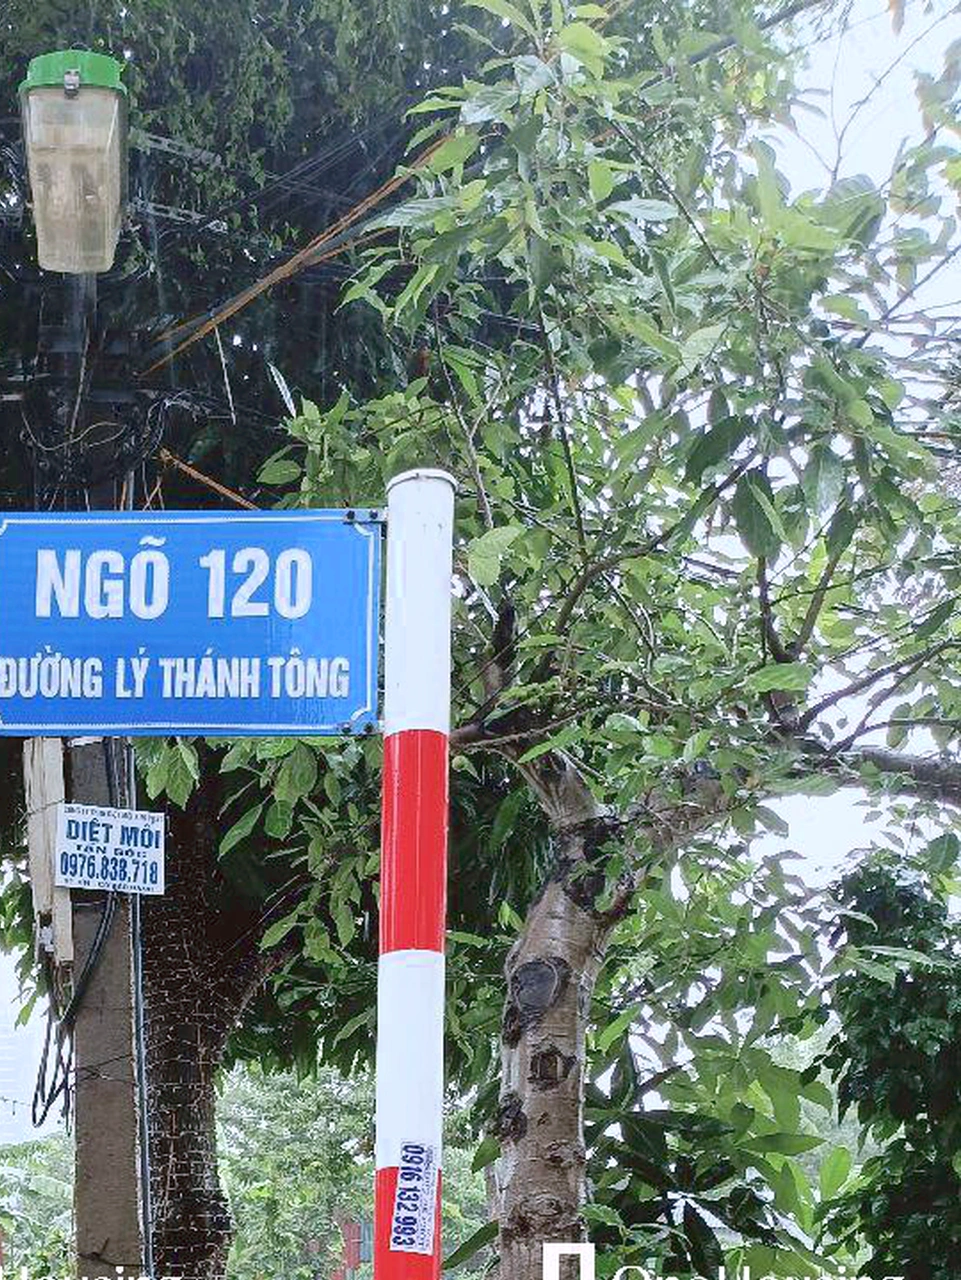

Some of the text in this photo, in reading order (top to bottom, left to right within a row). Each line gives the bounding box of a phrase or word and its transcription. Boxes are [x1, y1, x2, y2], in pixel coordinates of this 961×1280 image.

[35, 535, 313, 620] NGÕ 120
[115, 647, 150, 699] LÝ
[159, 647, 261, 699] THÁNH
[267, 647, 350, 699] TÔNG
